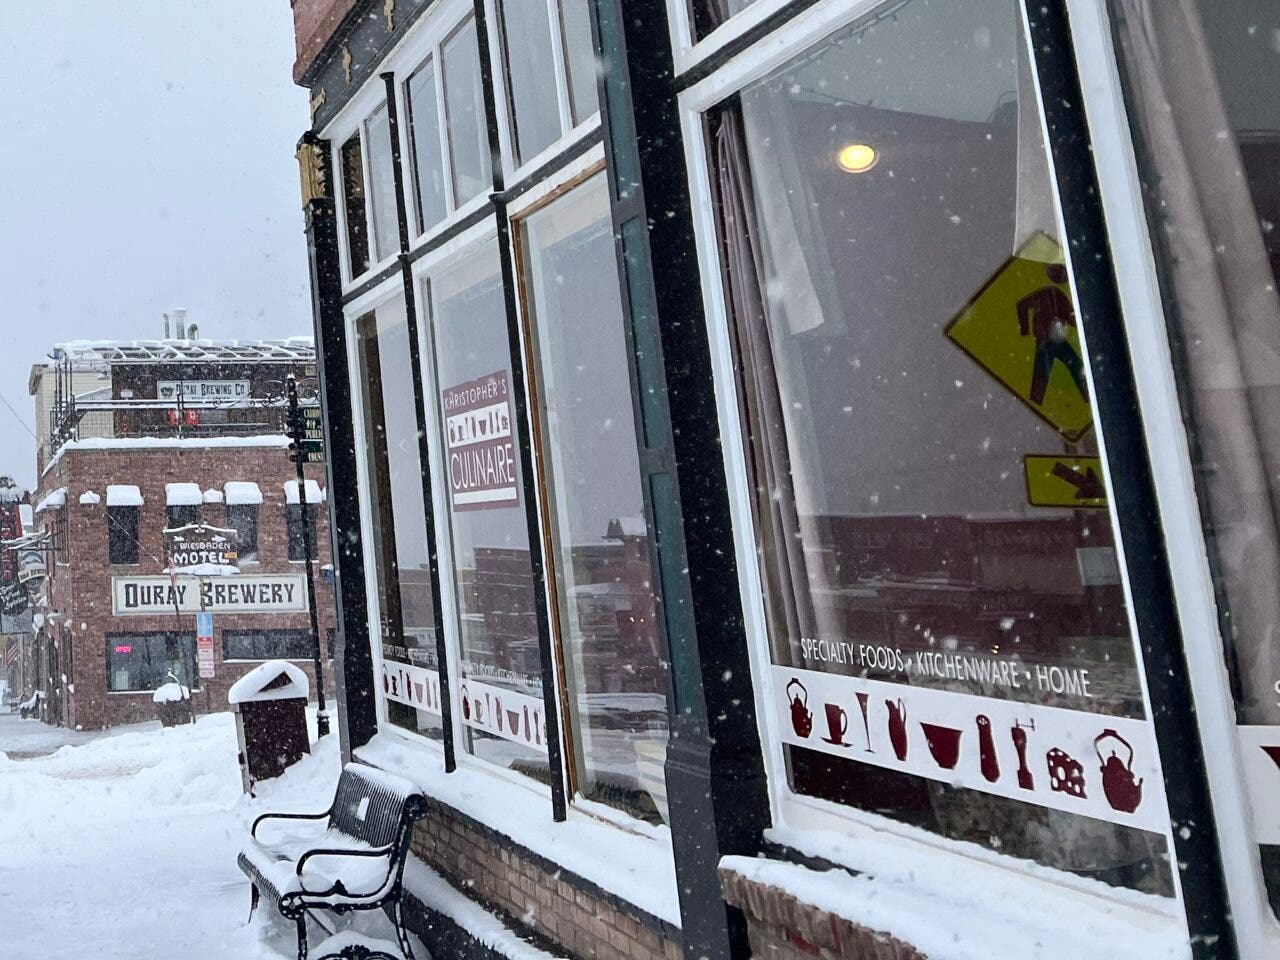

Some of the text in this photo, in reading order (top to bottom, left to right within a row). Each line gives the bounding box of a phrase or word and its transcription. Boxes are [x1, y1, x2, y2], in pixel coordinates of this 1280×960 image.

[450, 443, 515, 490] CULINAIRE
[173, 551, 230, 563] MOTEL
[124, 582, 295, 608] OURAY BREWERY
[800, 638, 1093, 698] SPECIALTY FOODS KITCHENWARE HOME
